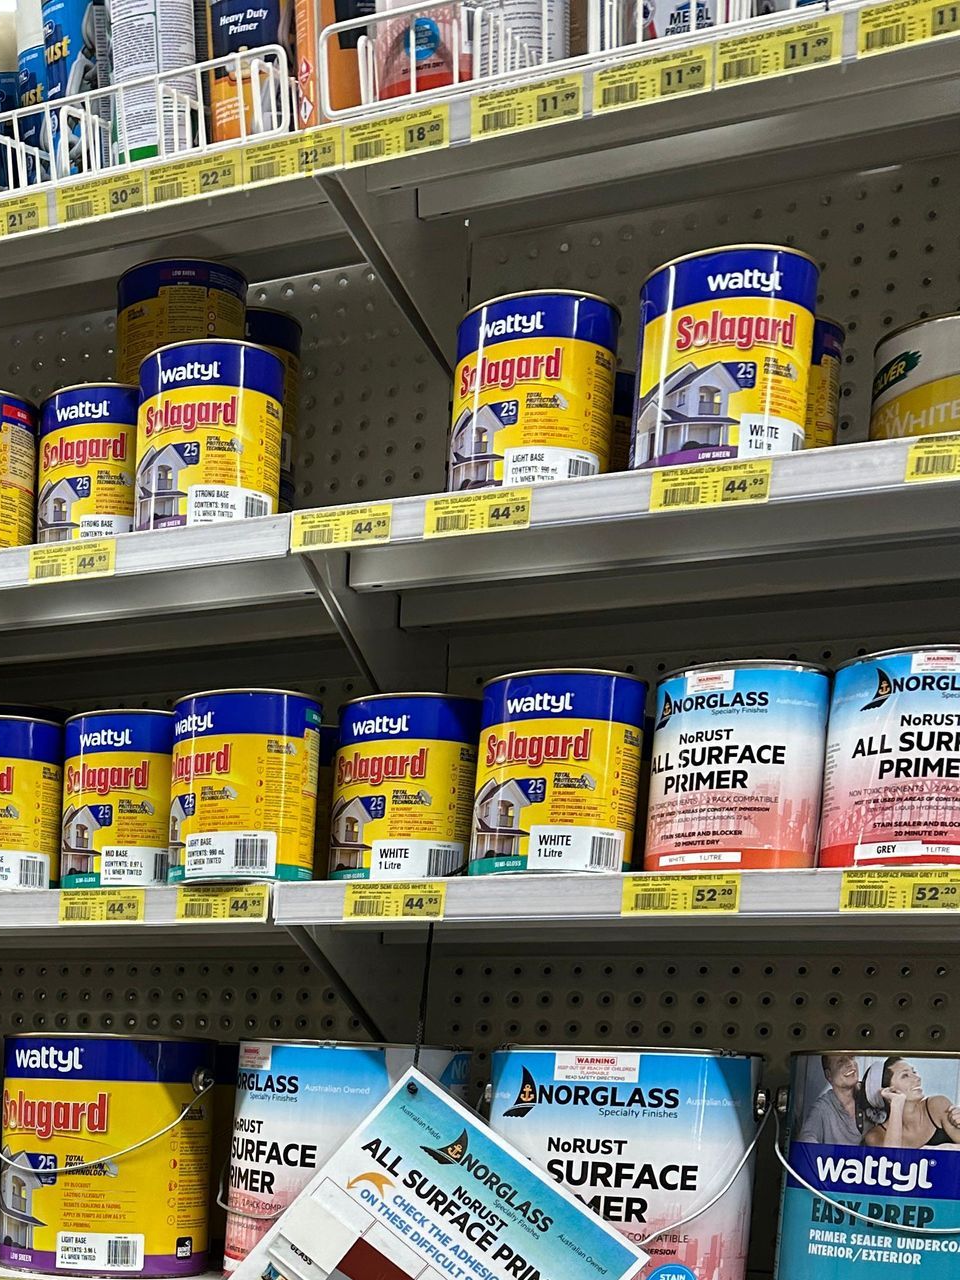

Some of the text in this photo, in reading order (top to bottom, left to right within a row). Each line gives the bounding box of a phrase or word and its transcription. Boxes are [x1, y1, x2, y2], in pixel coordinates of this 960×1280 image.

[220, 7, 269, 26] Heavy Duty
[229, 21, 259, 36] Primer
[707, 269, 781, 292] wattyl
[482, 312, 542, 338] wattyl
[676, 311, 796, 351] Solagard
[161, 360, 220, 384] wattyl
[460, 347, 561, 397] Solagard
[56, 399, 109, 422] wattyl
[145, 395, 239, 438] Solagard
[43, 433, 127, 471] Solagard
[512, 452, 544, 463] LIGHT BASE
[698, 451, 730, 460] LOW SHEEN
[507, 693, 571, 715] wattyl
[672, 692, 769, 715] NORGLASS
[80, 728, 130, 747] wattyl
[352, 714, 407, 736] wattyl
[679, 729, 734, 745] NoRUST
[486, 727, 592, 768] Solagard
[851, 734, 893, 759] ALL
[337, 748, 426, 786] Solagard
[651, 745, 786, 777] ALL SURFACE
[67, 760, 149, 796] Solagard
[664, 769, 749, 795] PRIMER
[379, 847, 409, 860] WHITE
[16, 1047, 82, 1072] wattyl
[576, 1057, 617, 1066] WARNING
[304, 1083, 371, 1095] Australian Owned
[538, 1085, 679, 1109] NORGLASS
[3, 1088, 107, 1138] Solagard
[599, 1107, 678, 1119] Specialty Finishes
[232, 1136, 318, 1169] SURFACE
[547, 1136, 628, 1155] NoRUST
[547, 1158, 698, 1191] SURFACE
[816, 1155, 933, 1192] wattyl
[361, 1138, 400, 1178] ALL
[402, 1169, 500, 1253] SURFACE
[460, 1153, 553, 1234] NORGLASS
[392, 1194, 429, 1226] CHECK
[427, 1222, 453, 1247] THE
[452, 1185, 509, 1233] NoRUST
[811, 1197, 934, 1230] EASY PREP
[360, 1188, 377, 1206] ON
[374, 1201, 413, 1236] THESE
[409, 1231, 464, 1280] DIFFICULT
[809, 1229, 893, 1249] PRIMER SEALER
[290, 1244, 314, 1266] GLASS
[808, 1243, 922, 1265] INTERIOR/EXTERIOR
